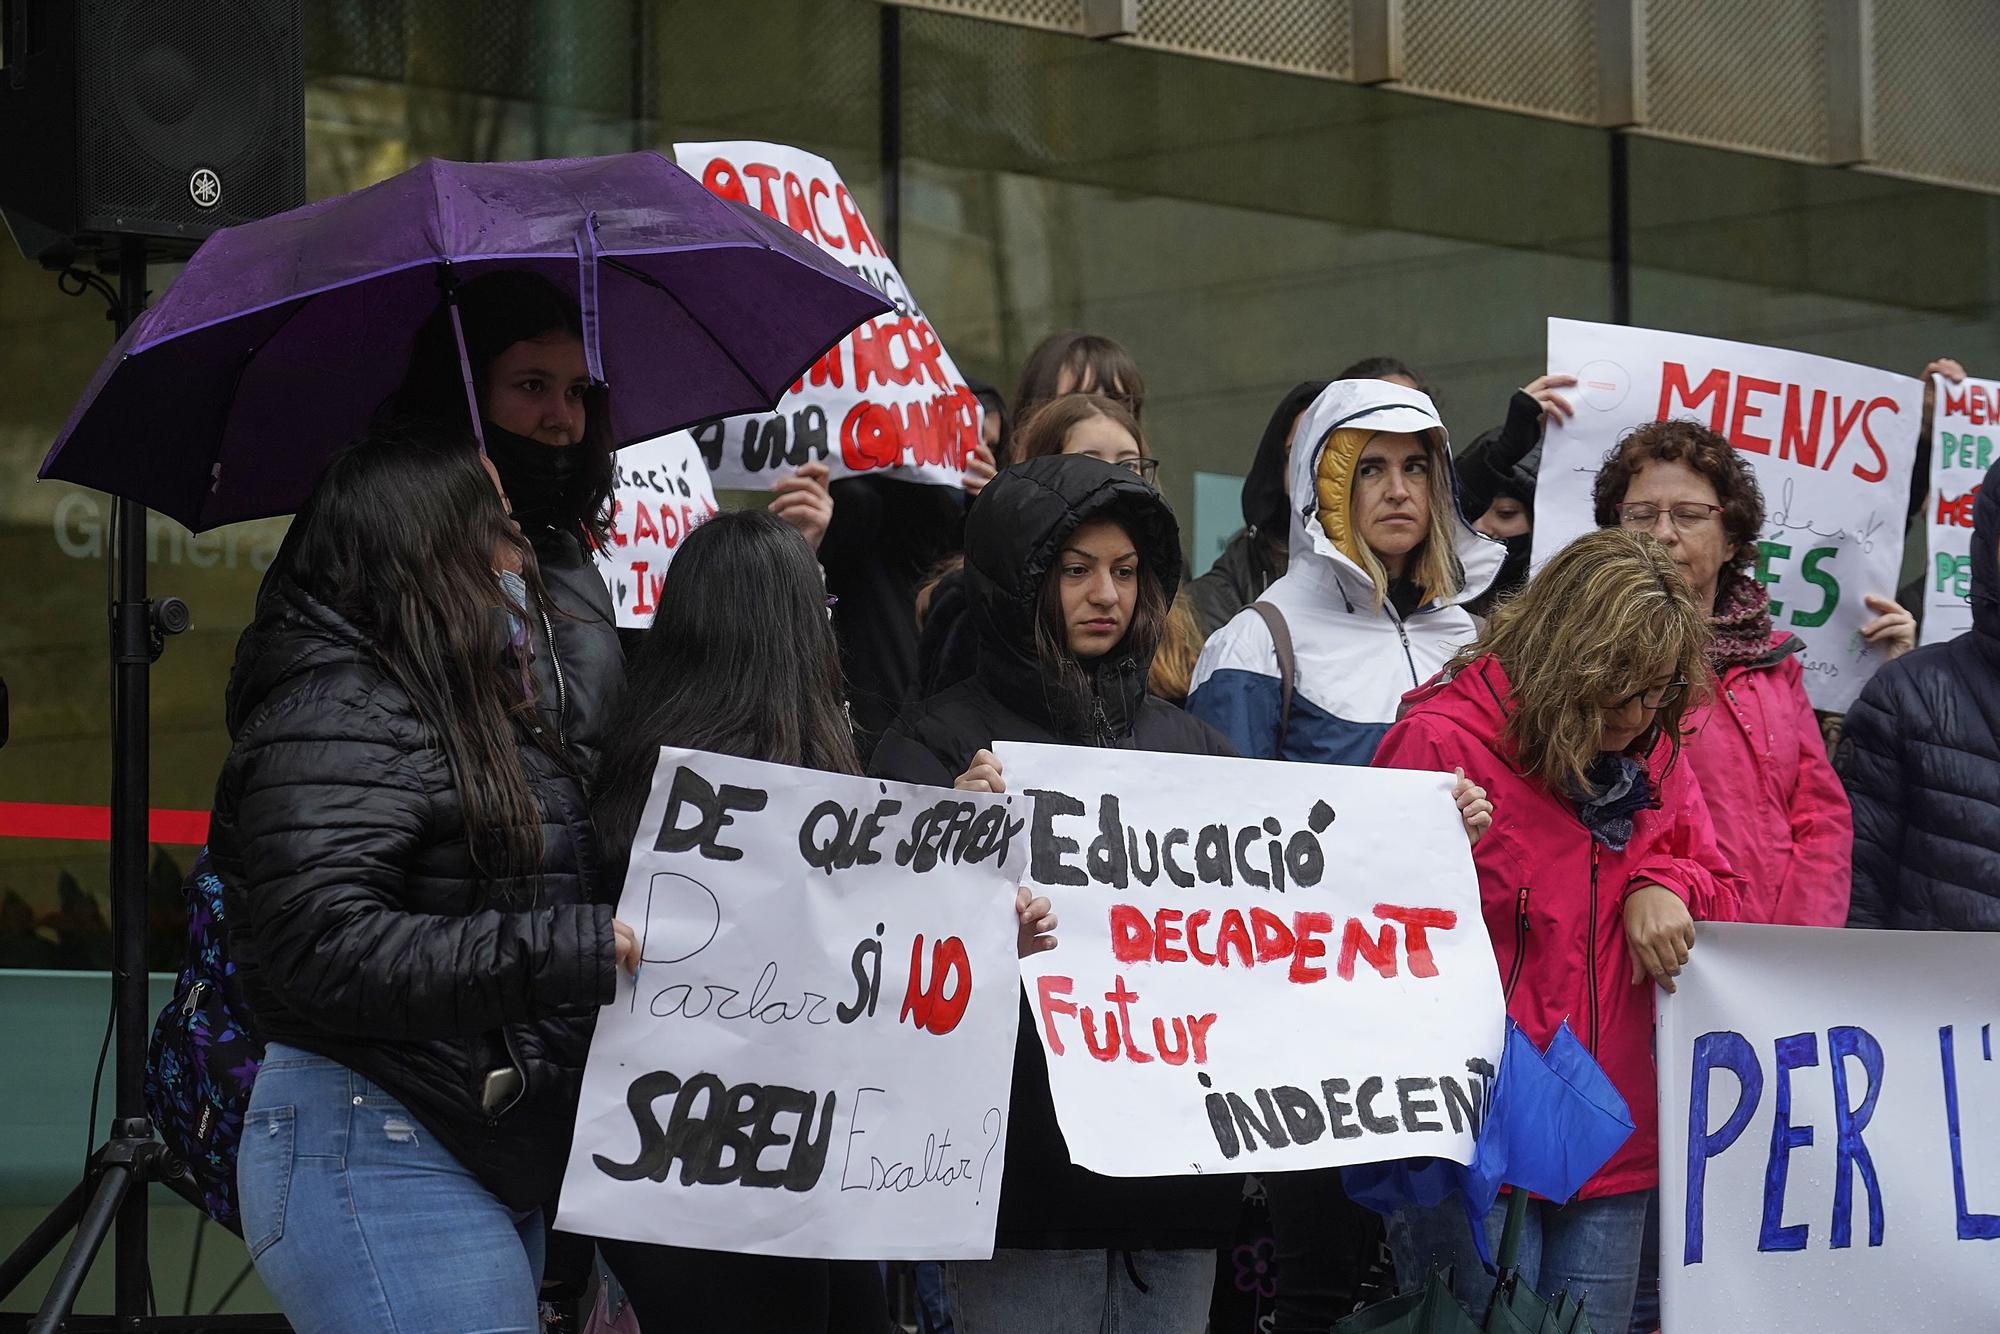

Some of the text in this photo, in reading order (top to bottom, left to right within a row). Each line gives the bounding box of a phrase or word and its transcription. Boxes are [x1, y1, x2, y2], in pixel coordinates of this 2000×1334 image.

[1656, 361, 1900, 483] MENYS
[653, 766, 768, 861] DE
[798, 782, 902, 875] QUÈ
[1022, 788, 1336, 894] Educació
[630, 872, 831, 1025] Parlar
[899, 933, 973, 1036] NO
[1108, 902, 1458, 984] DECADENT
[1036, 974, 1218, 1066] Futur
[592, 1070, 837, 1192] SABEU
[1684, 1025, 1885, 1267] PER
